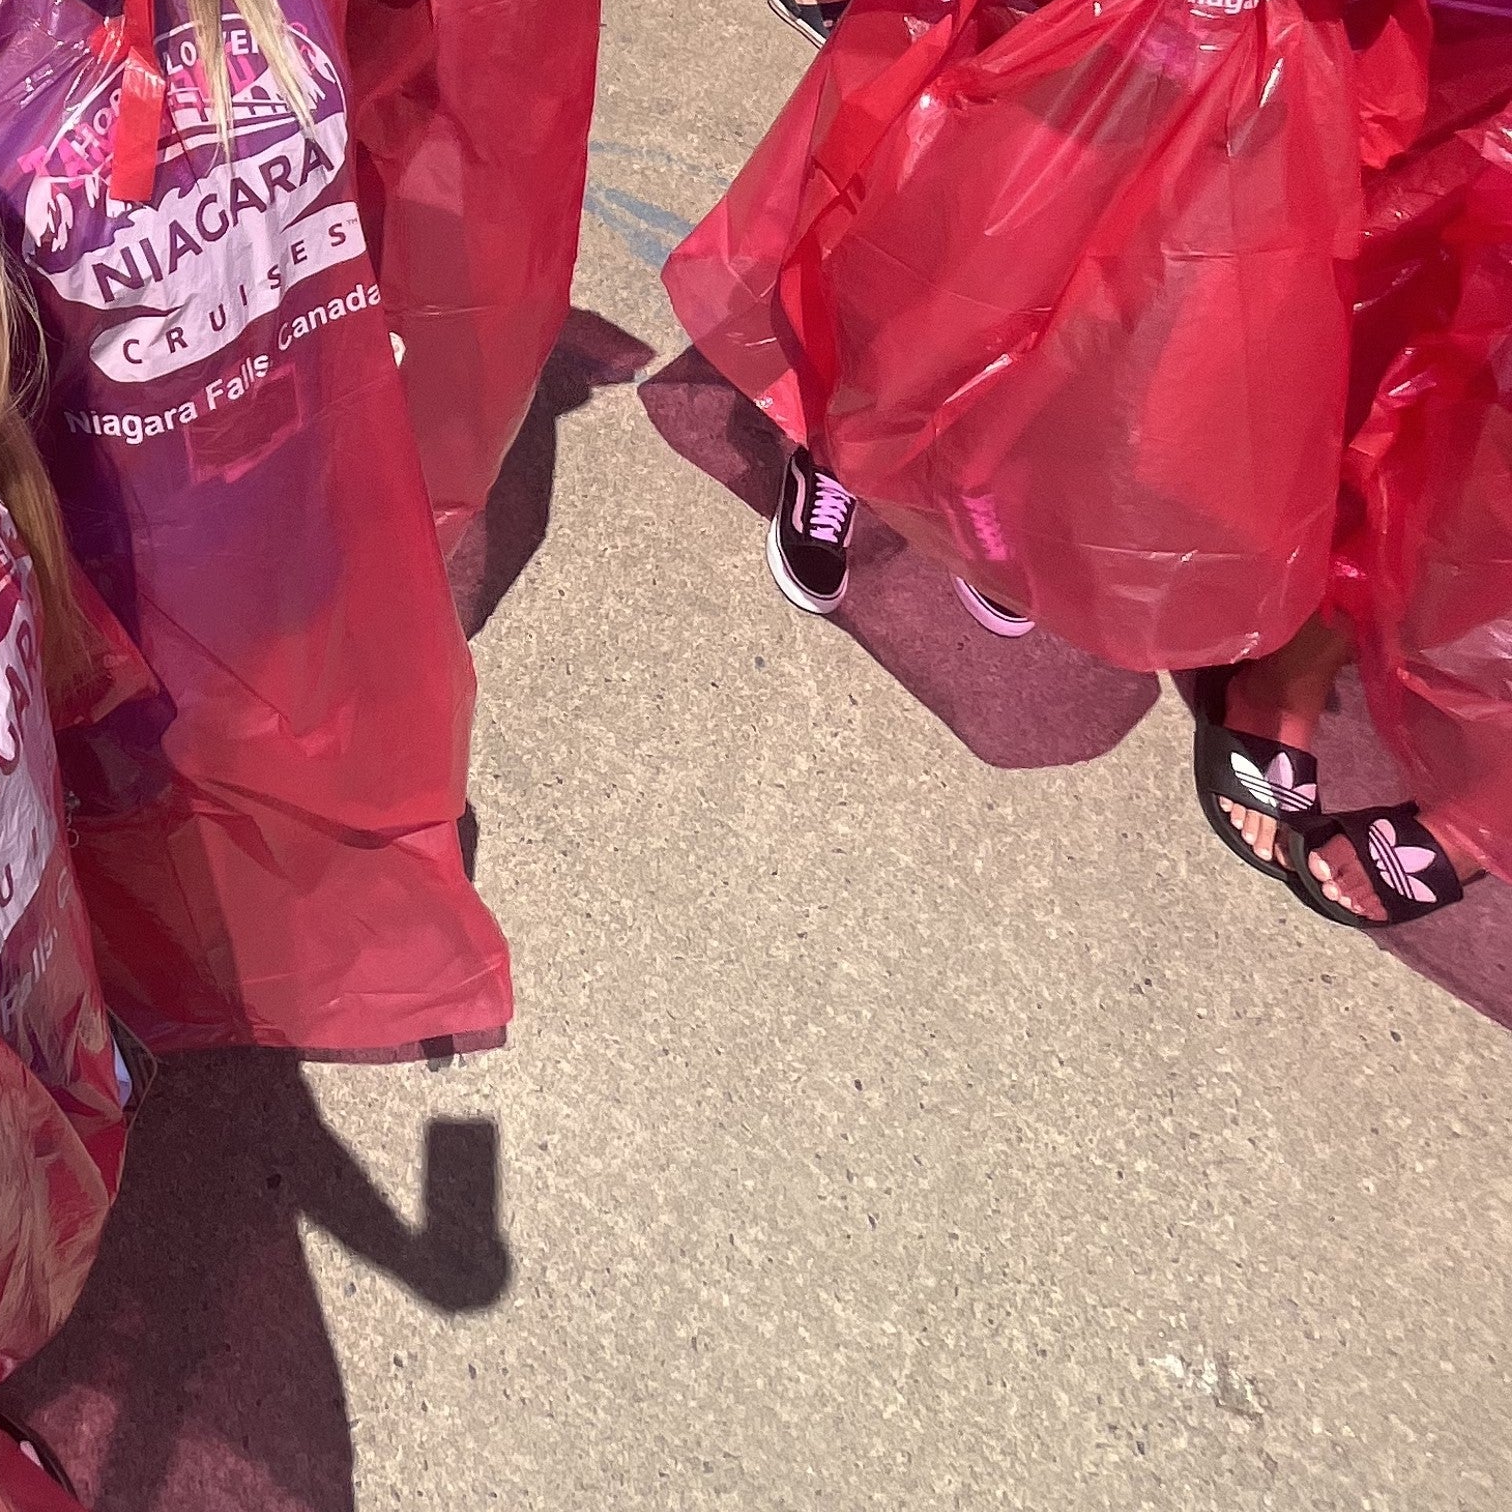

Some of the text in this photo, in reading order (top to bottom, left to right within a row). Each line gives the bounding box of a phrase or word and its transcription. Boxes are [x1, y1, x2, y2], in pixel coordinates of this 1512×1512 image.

[90, 138, 333, 303] NIAGARA
[64, 283, 381, 445] Niagara Falls Canada
